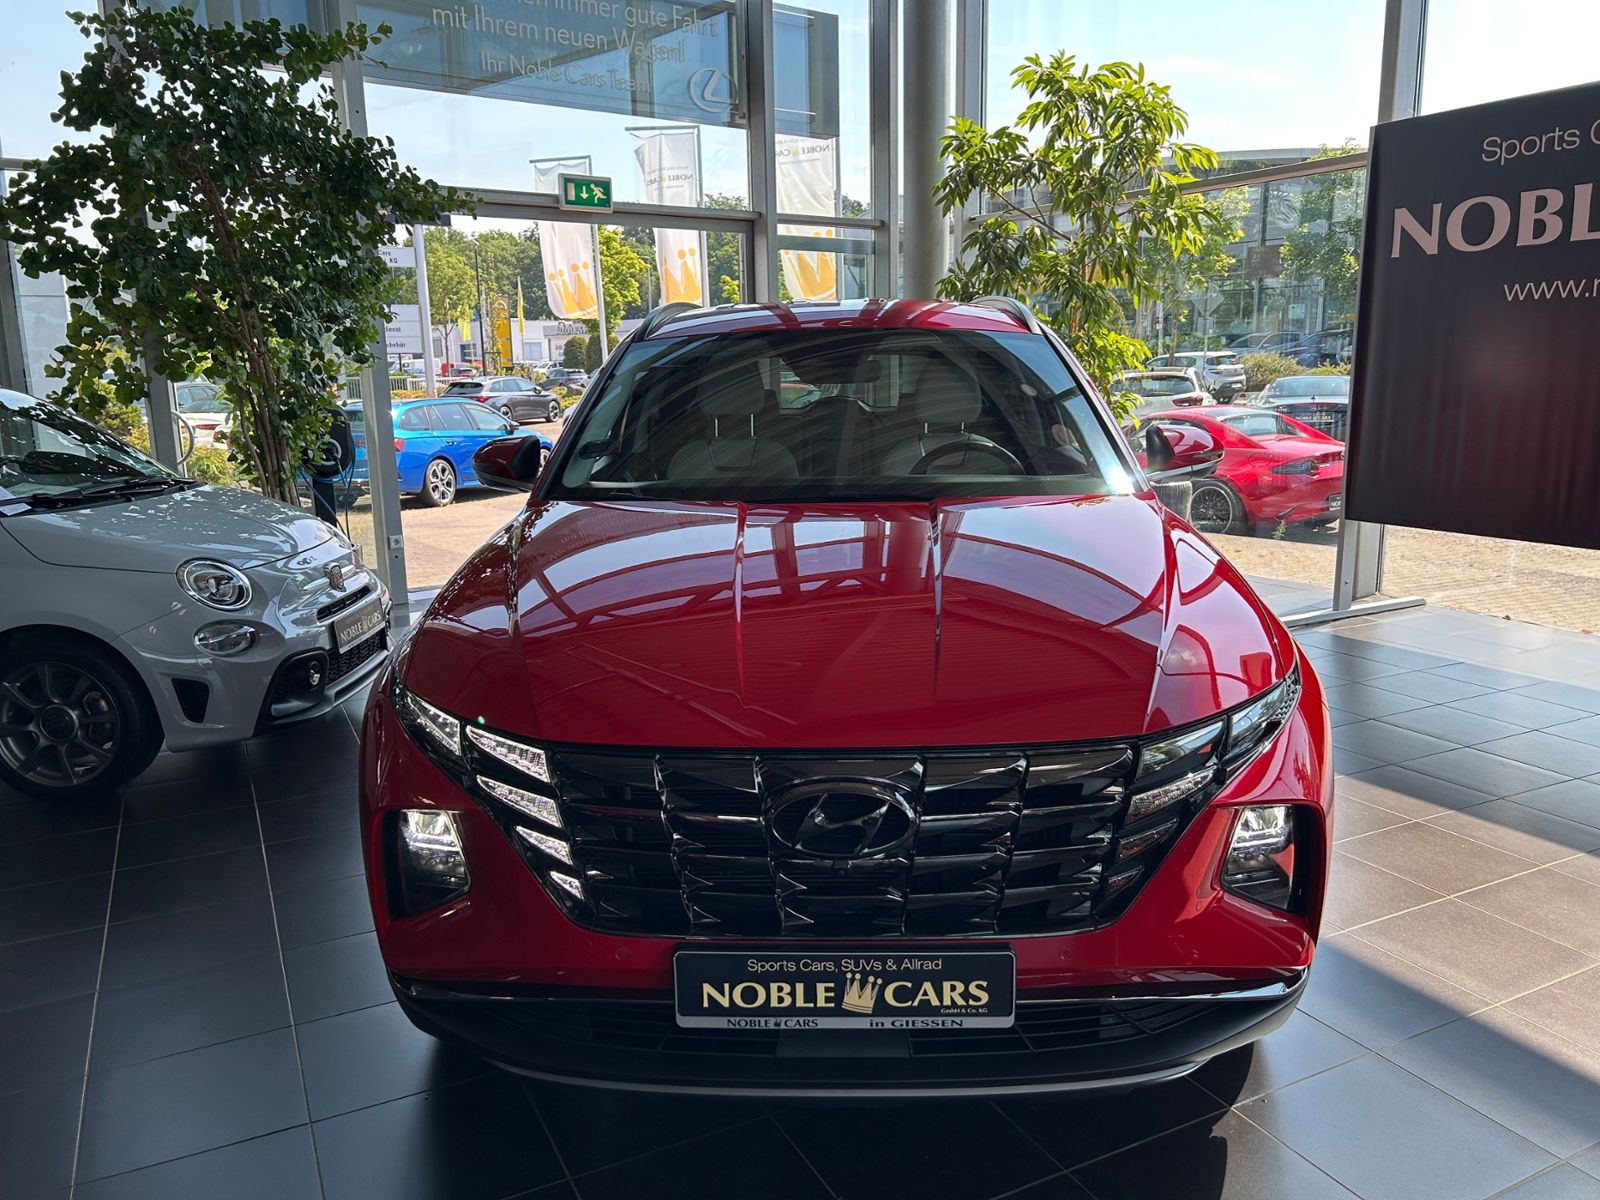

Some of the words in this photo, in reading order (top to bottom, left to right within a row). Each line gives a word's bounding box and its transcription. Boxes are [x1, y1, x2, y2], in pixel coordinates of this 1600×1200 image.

[432, 5, 468, 29] mit
[474, 4, 538, 39] Ihrem
[545, 26, 608, 50] neuen
[625, 7, 667, 28] gute
[672, 5, 719, 37] Fahrt
[480, 50, 504, 73] Ihr
[510, 54, 562, 82] Noble
[565, 63, 606, 88] Cars
[607, 68, 651, 92] Team
[1481, 127, 1580, 166] Sports
[1391, 183, 1600, 259] NOBL
[340, 621, 363, 643] NOBLE
[747, 959, 797, 973] Sports
[799, 959, 838, 973] Cars,
[841, 959, 882, 971] SUVs
[886, 959, 897, 971] &
[900, 958, 942, 971] Allrad
[702, 981, 835, 1008] NOBLE
[884, 981, 990, 1007] CARS
[726, 1018, 771, 1028] NOBLE
[784, 1018, 818, 1028] CARS
[869, 1019, 885, 1028] in
[891, 1019, 963, 1028] GIESSEN
